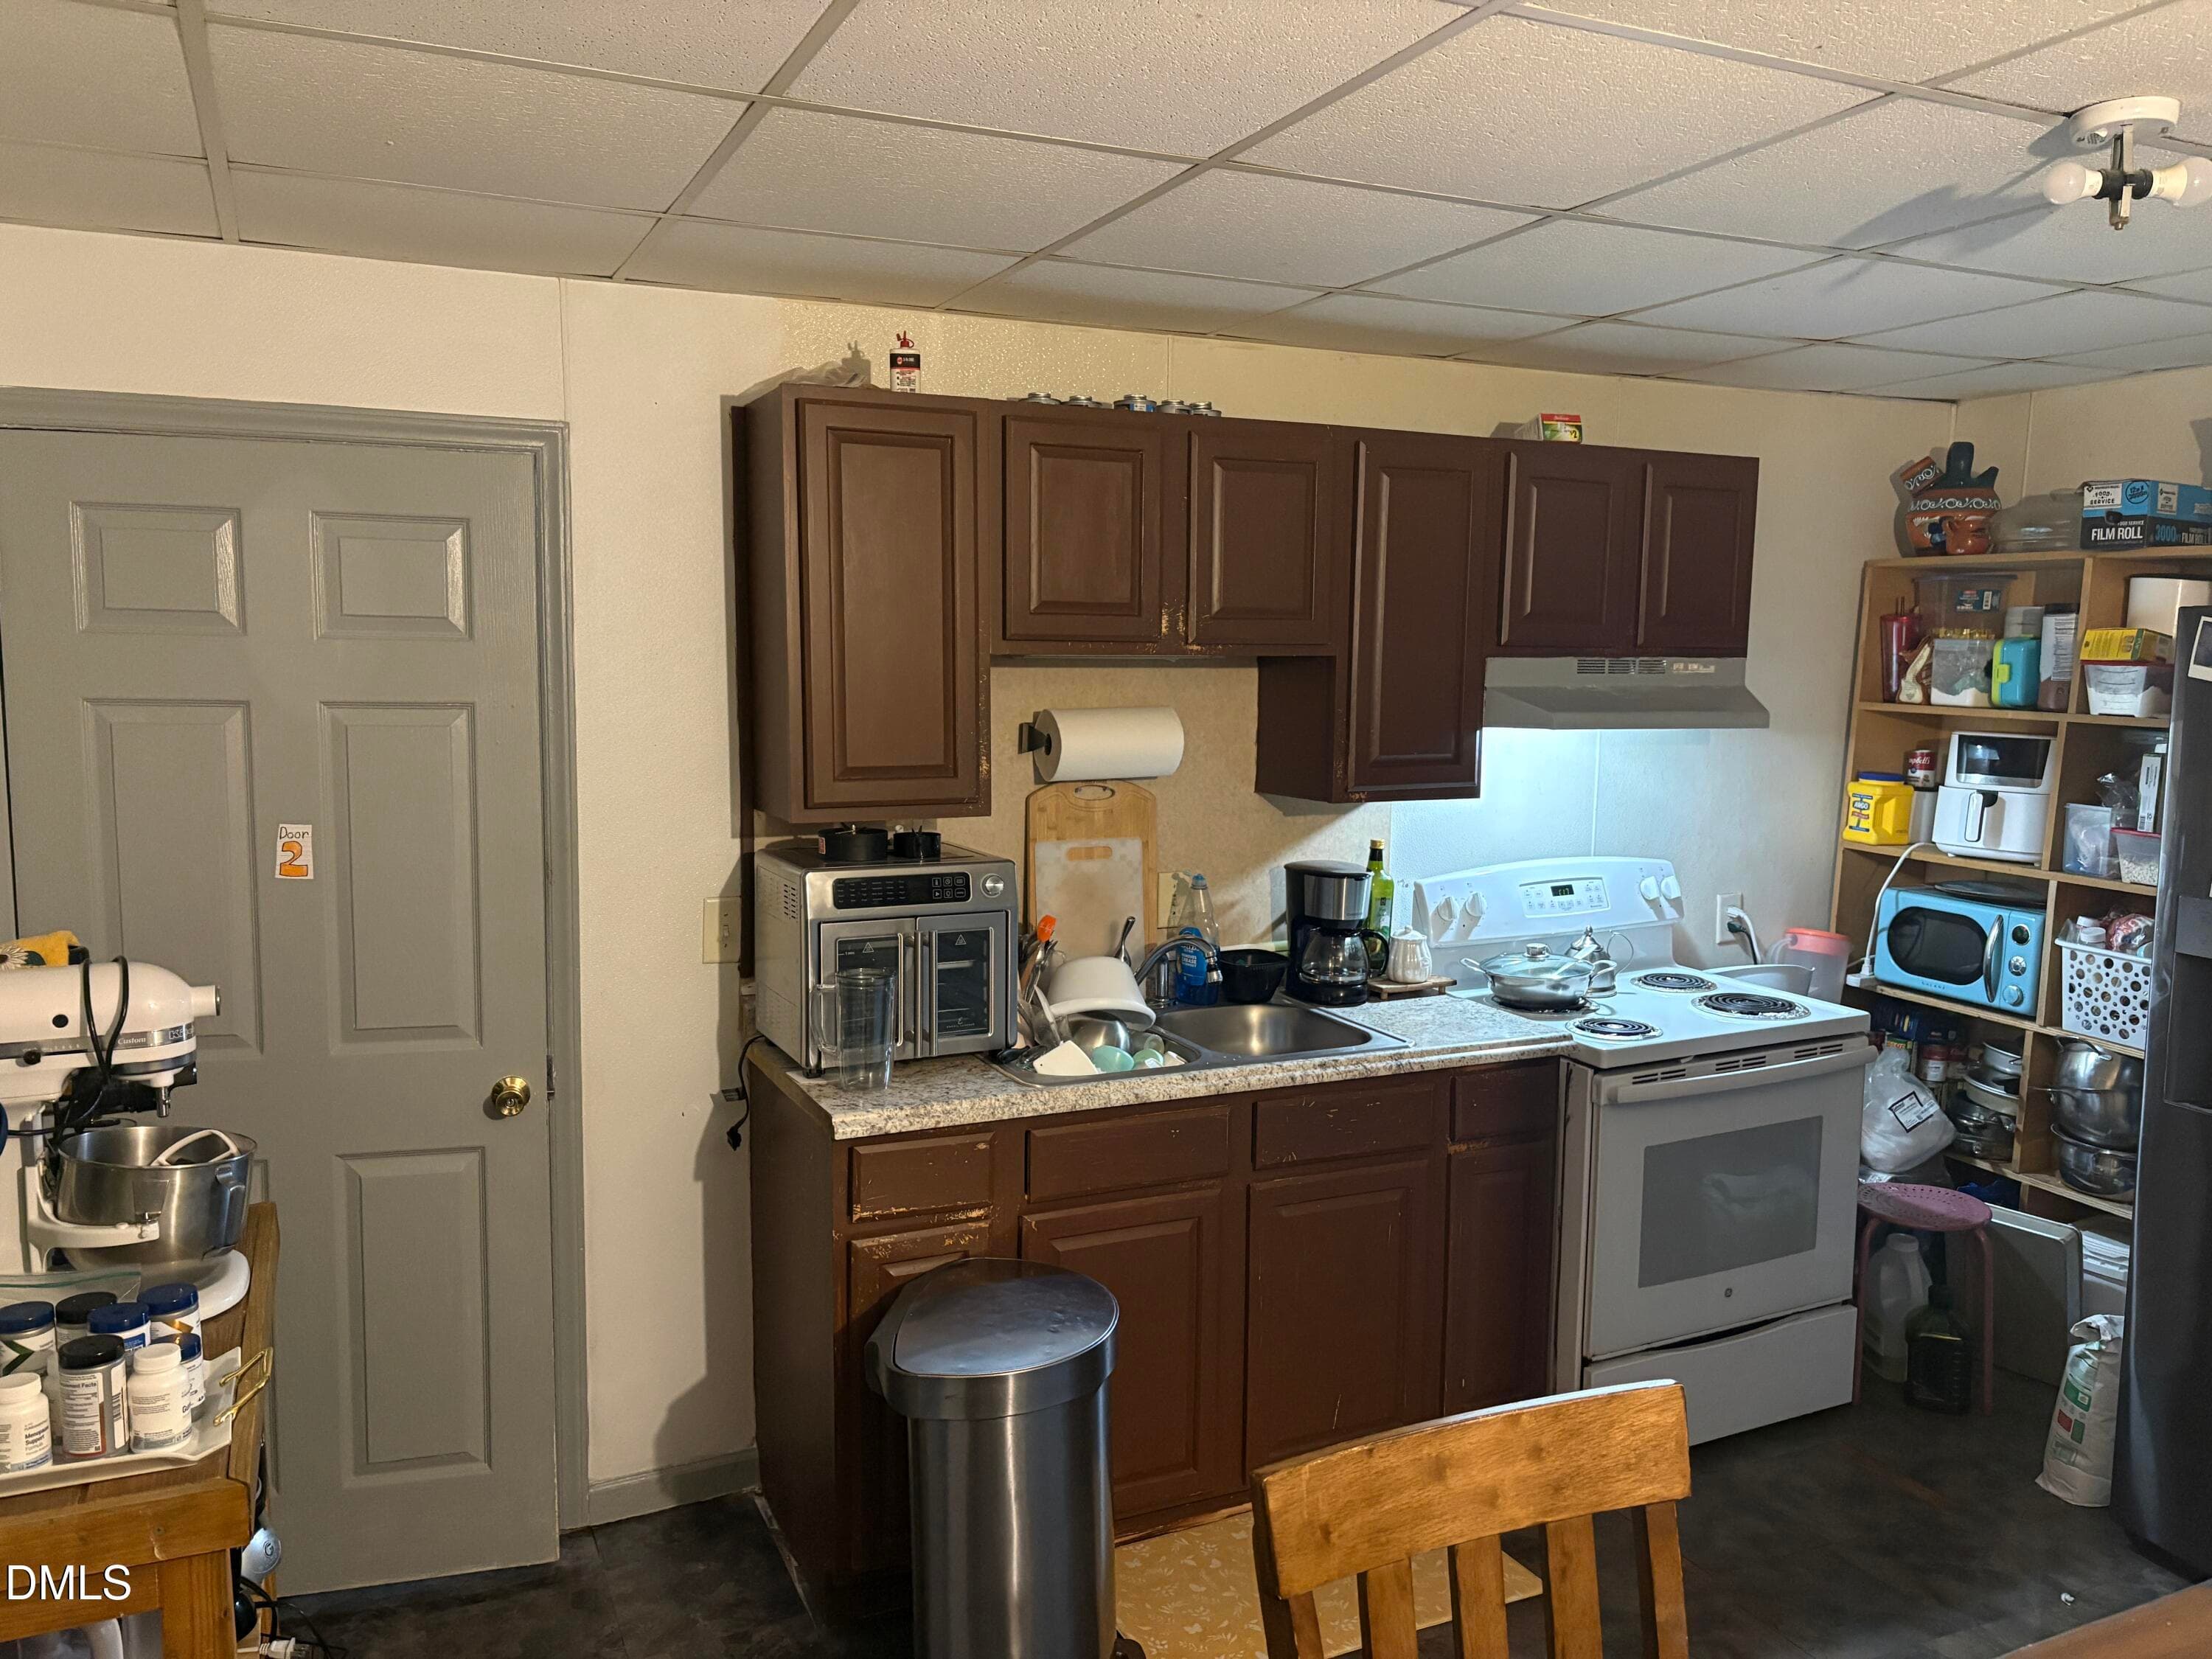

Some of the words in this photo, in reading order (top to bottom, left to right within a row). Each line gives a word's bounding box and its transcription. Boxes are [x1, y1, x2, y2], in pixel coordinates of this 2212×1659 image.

[2091, 527, 2115, 541] FILM
[2117, 526, 2143, 540] ROLL
[1854, 801, 1868, 810] ARGO
[279, 827, 309, 840] Door
[279, 841, 308, 877] 2
